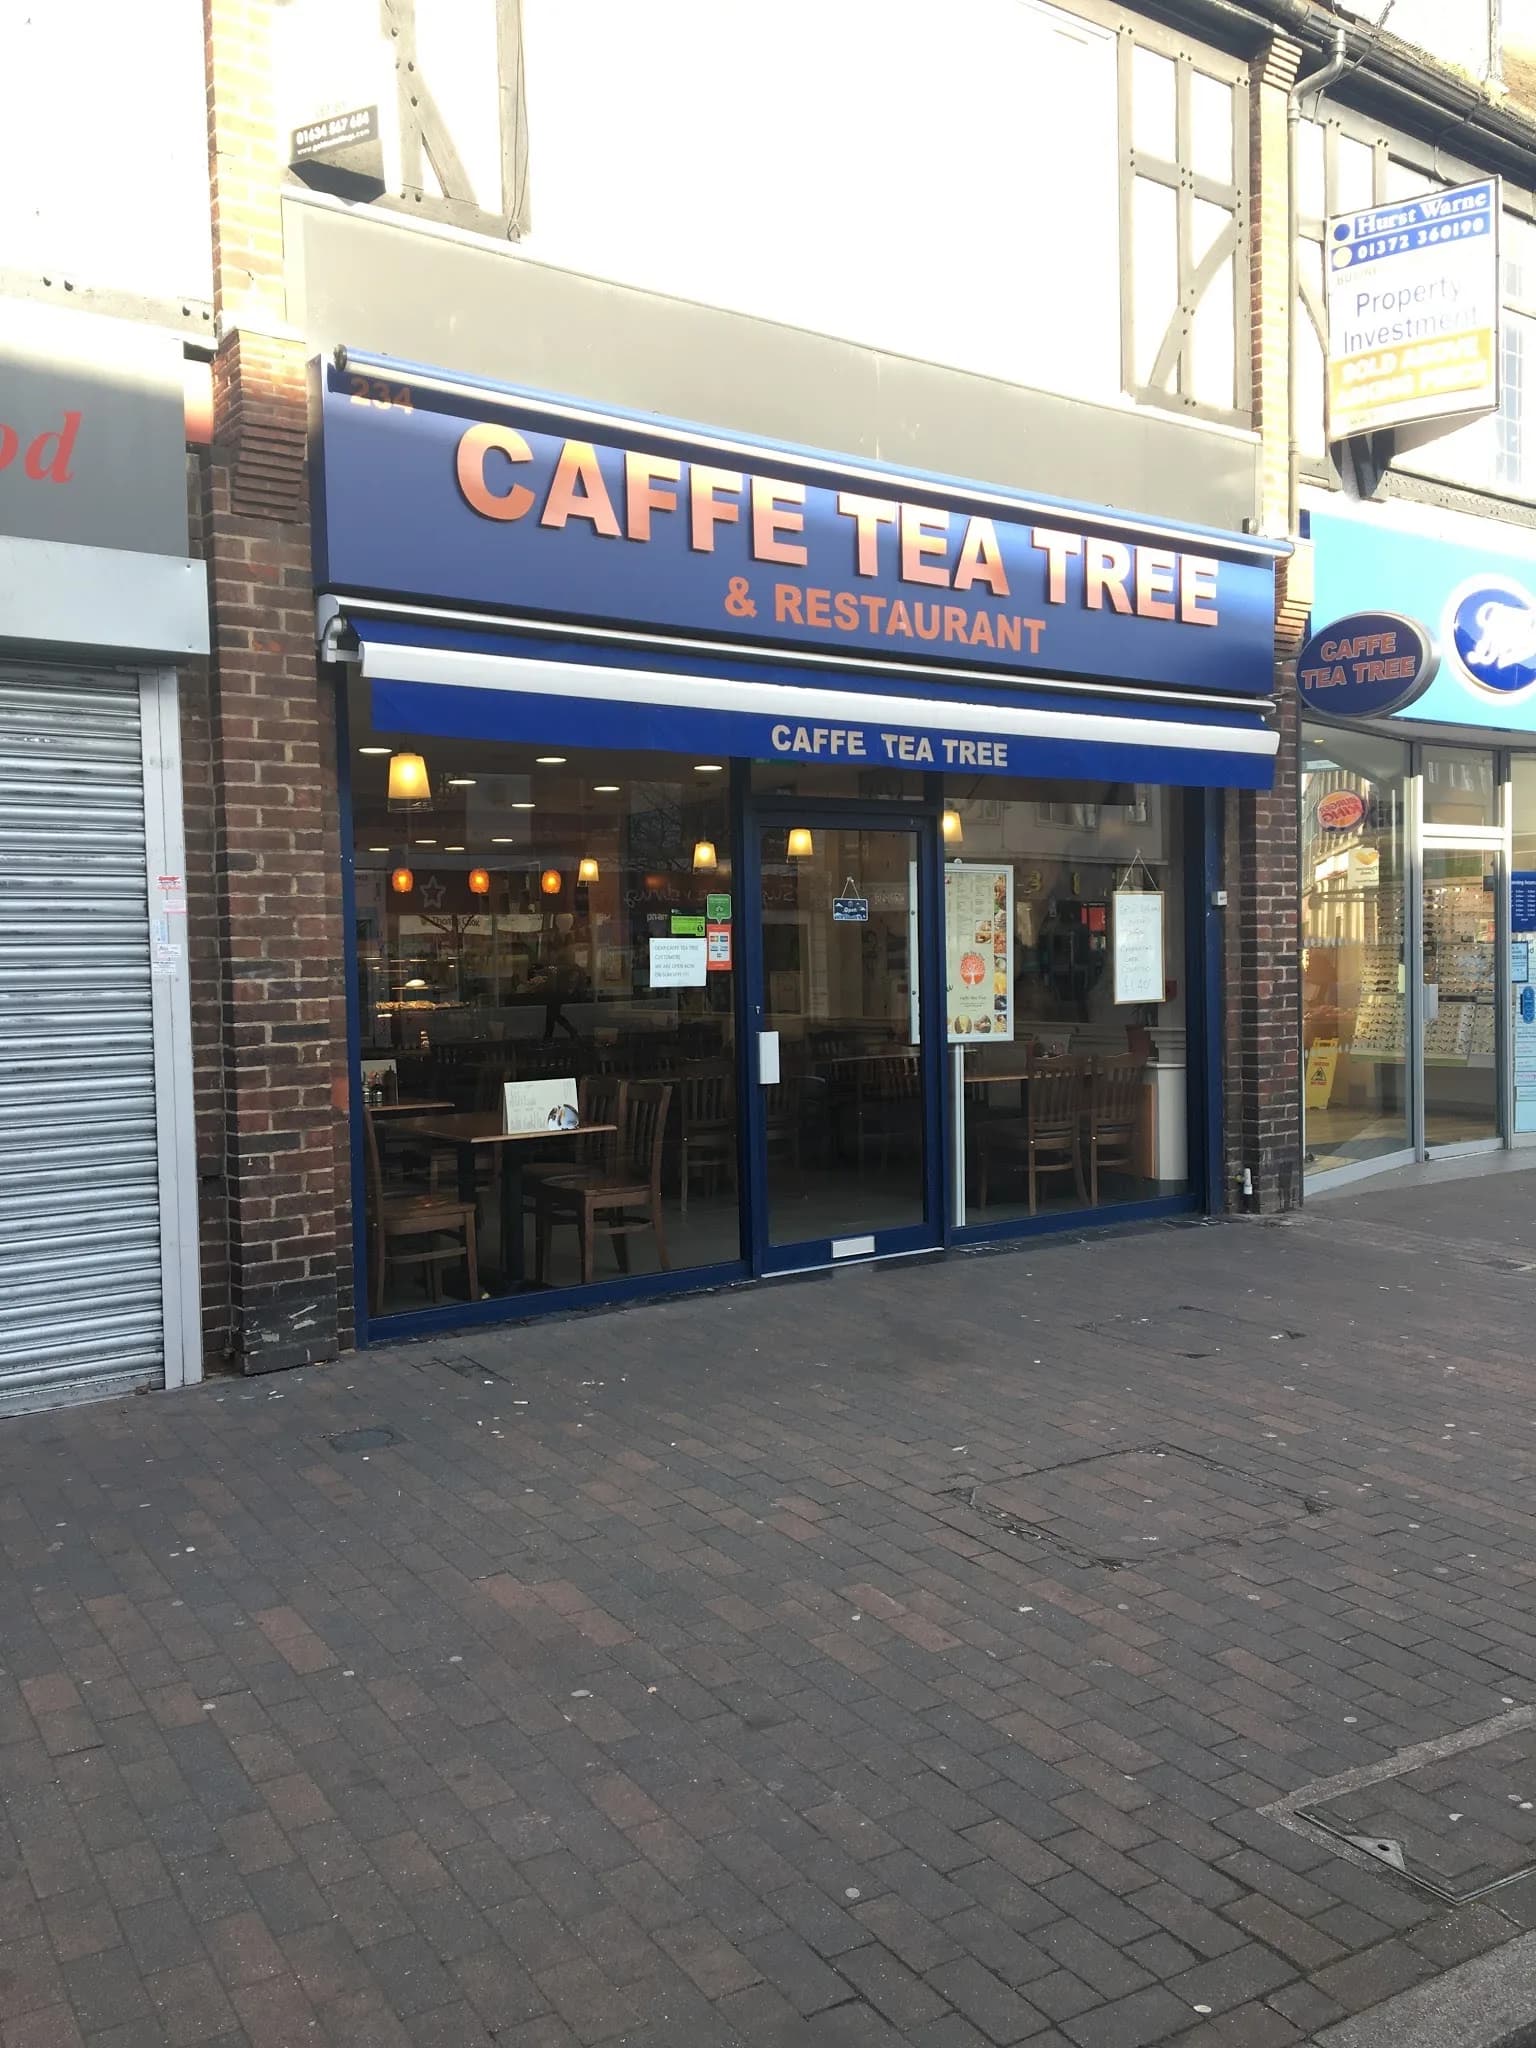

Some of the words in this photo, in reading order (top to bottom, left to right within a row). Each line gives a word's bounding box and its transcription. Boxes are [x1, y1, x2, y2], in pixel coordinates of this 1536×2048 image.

[1356, 208, 1417, 236] Hurst
[1419, 192, 1488, 219] Warne
[1356, 235, 1410, 260] 01372
[1417, 217, 1485, 245] 360190
[1356, 277, 1462, 318] Property
[1343, 305, 1477, 354] Investment
[350, 376, 415, 415] 234
[456, 422, 808, 567] CAFFE
[837, 491, 1011, 596] TEA
[1031, 526, 1219, 627] TREE
[724, 575, 758, 619] &
[775, 583, 1047, 655] RESTAURANT
[1320, 631, 1397, 662] CAFFE
[1301, 665, 1348, 690] TEA
[1352, 655, 1416, 684] TREE
[771, 724, 867, 756] CAFFE
[880, 732, 934, 763] TEA
[942, 738, 1009, 767] TREE
